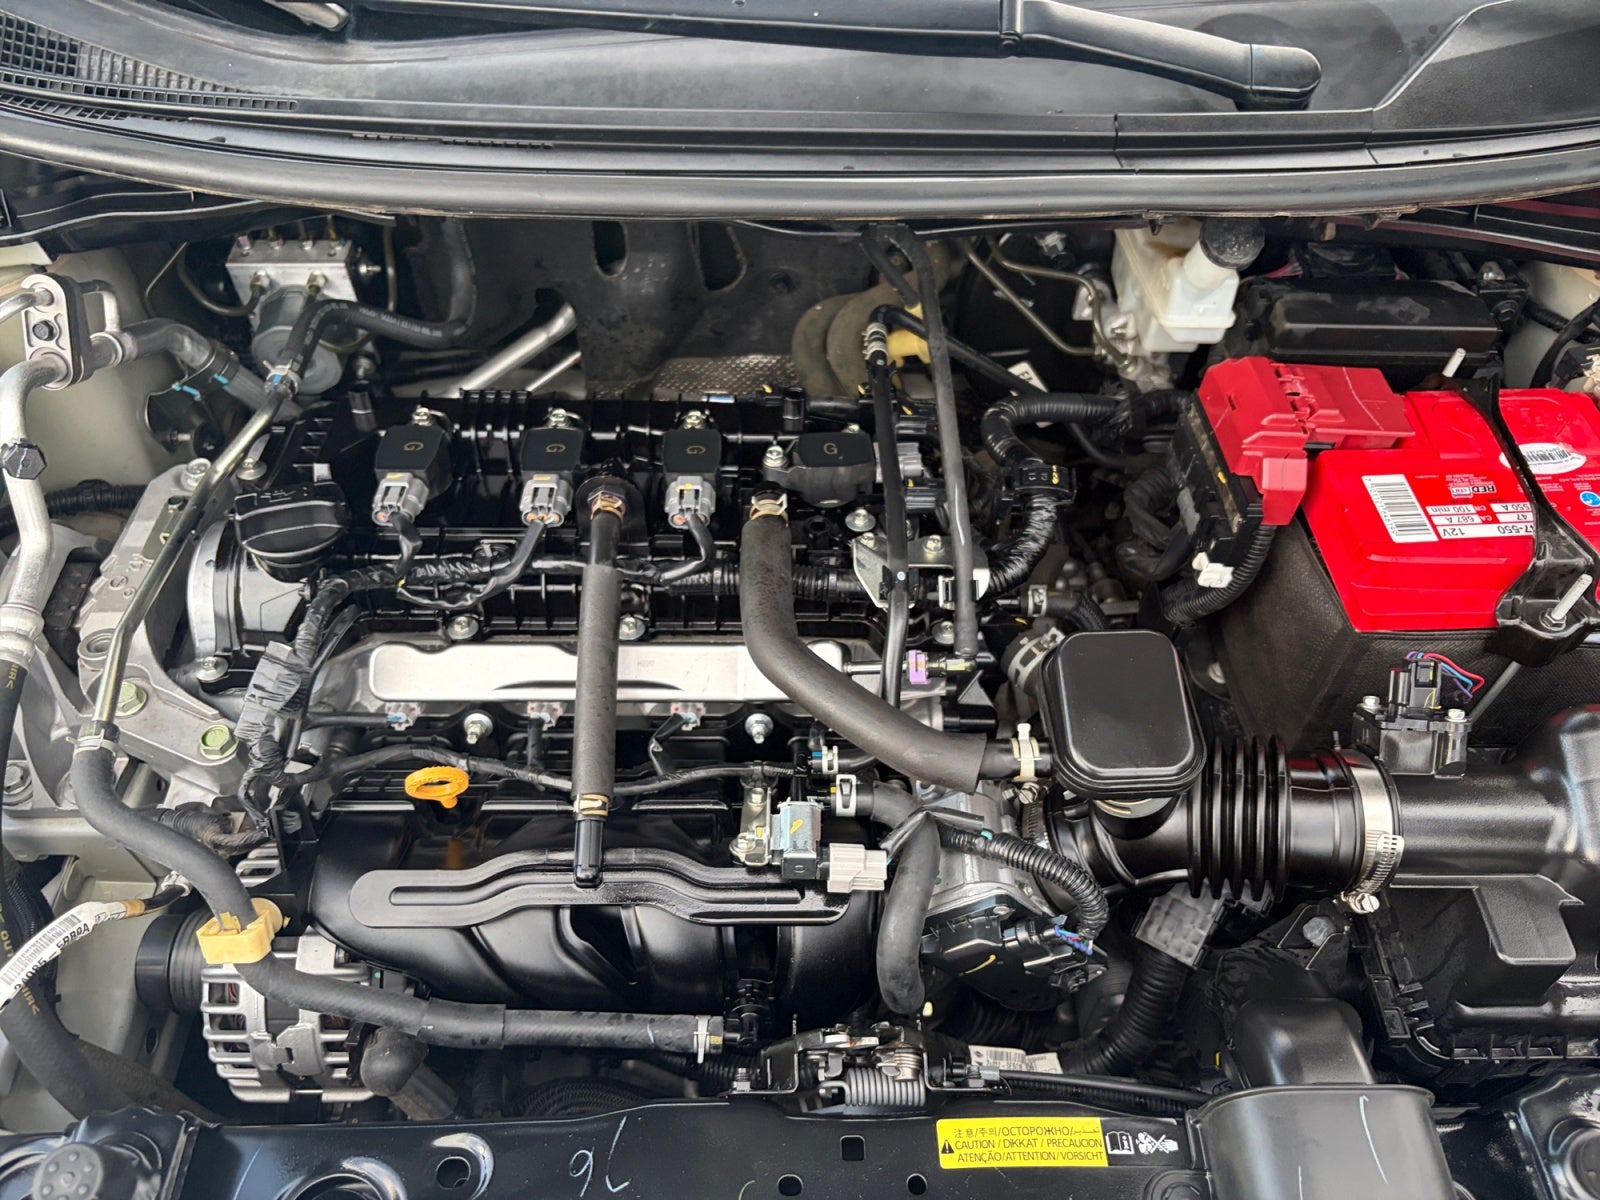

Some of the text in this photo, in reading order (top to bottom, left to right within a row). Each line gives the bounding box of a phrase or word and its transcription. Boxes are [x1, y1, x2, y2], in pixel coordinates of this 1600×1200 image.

[1472, 485, 1495, 493] RED
[1453, 505, 1471, 513] 100
[1443, 527, 1466, 537] 12V
[955, 1140, 996, 1150] CAUTION
